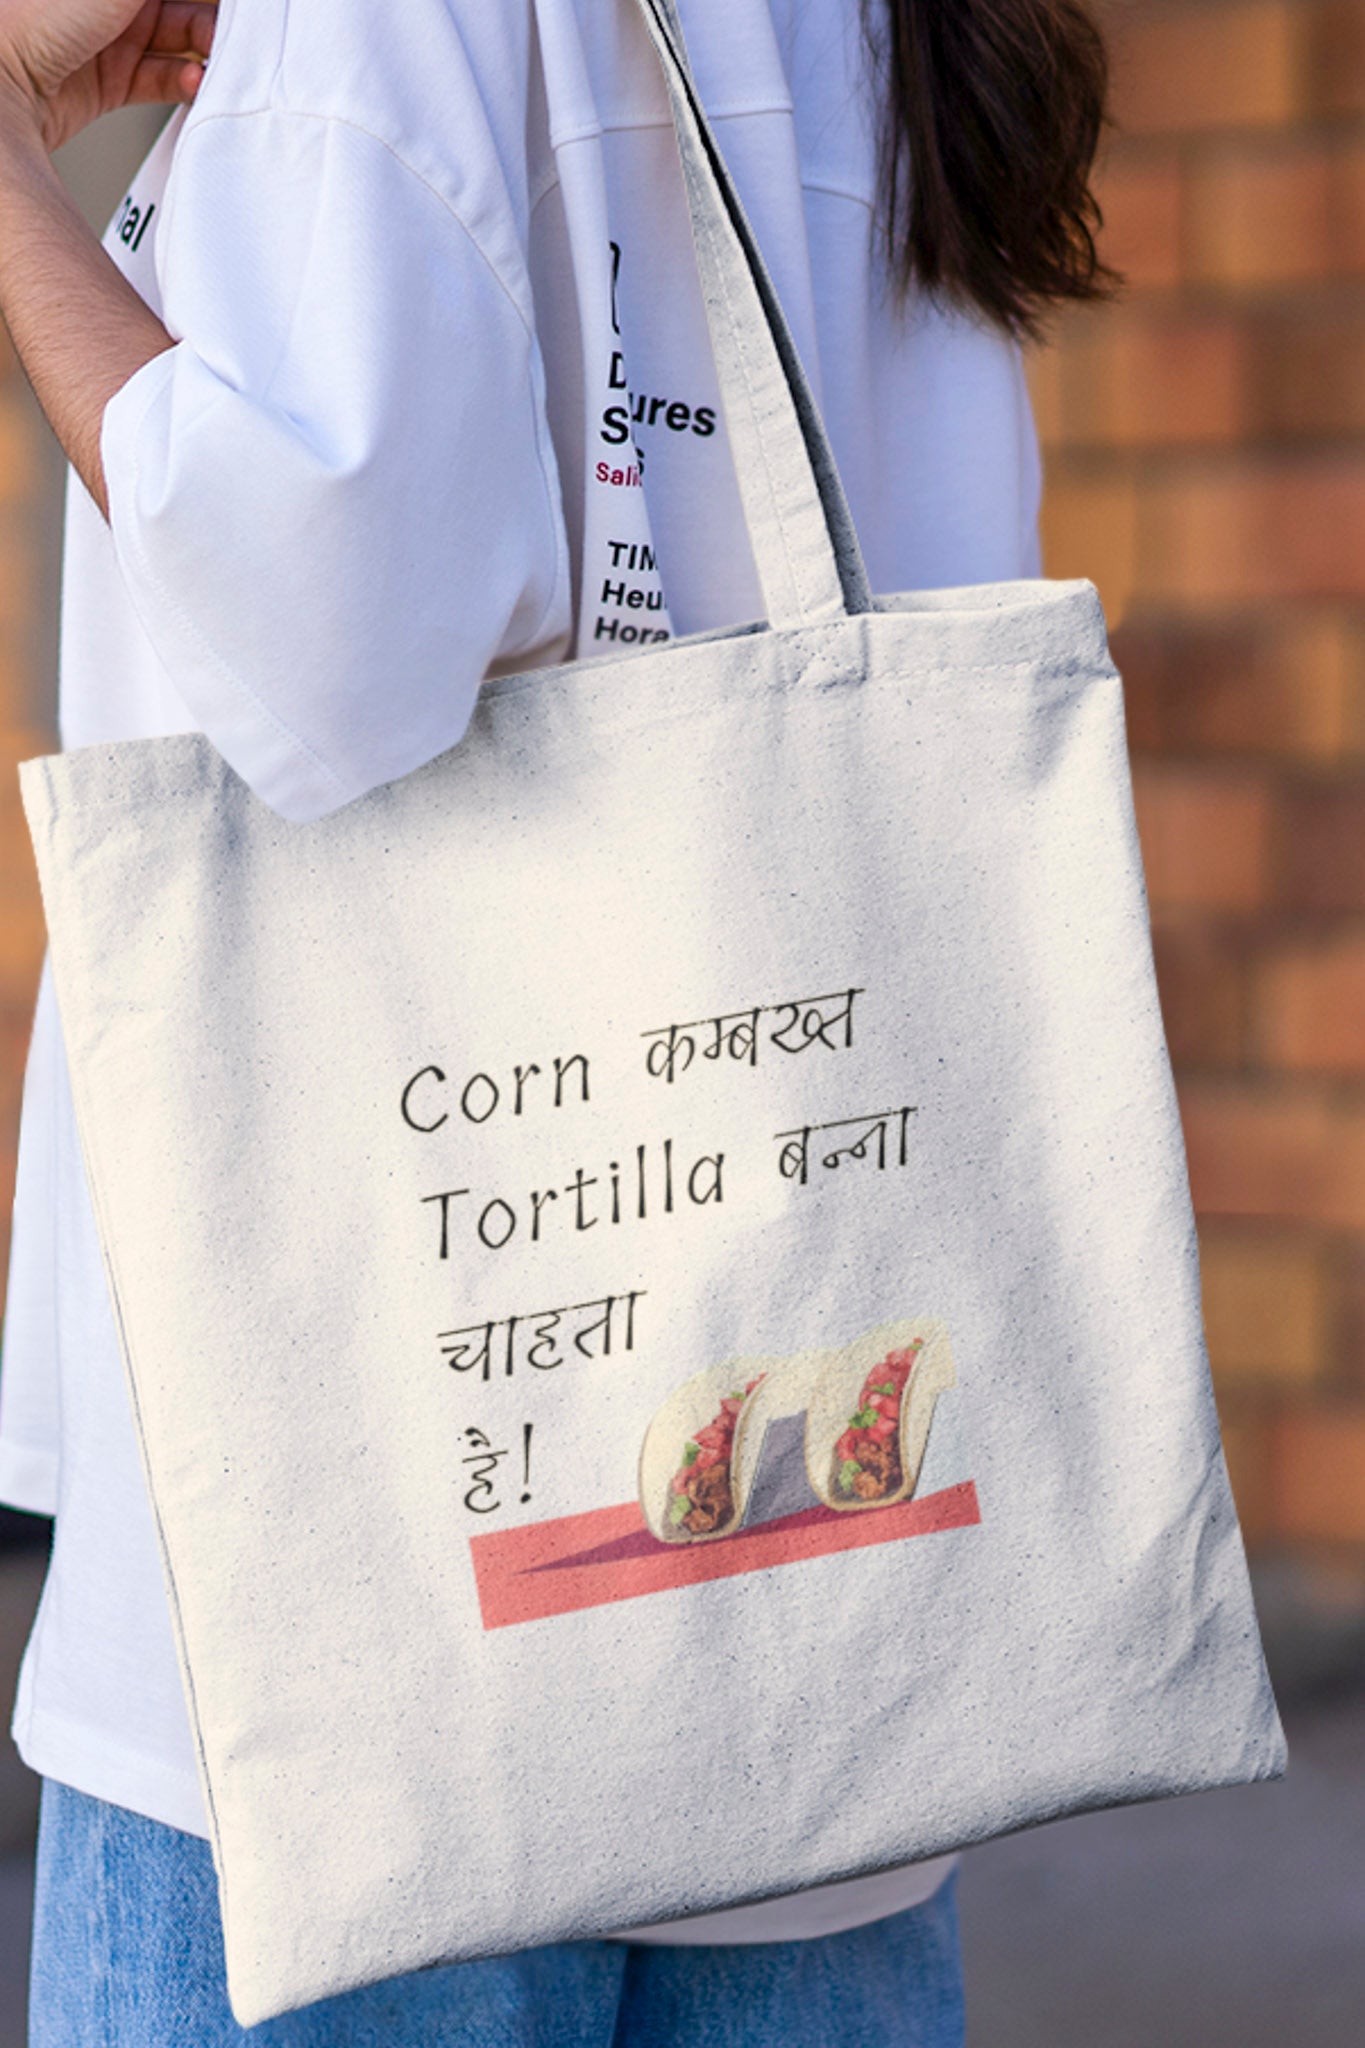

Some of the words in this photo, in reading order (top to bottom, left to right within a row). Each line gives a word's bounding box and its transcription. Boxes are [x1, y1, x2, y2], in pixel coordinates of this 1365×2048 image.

[595, 461, 643, 487] Sali
[600, 579, 668, 610] Heu
[400, 1053, 590, 1133] Corn
[640, 988, 866, 1084] कम्बख्त
[421, 1138, 725, 1260] Tortilla
[436, 1291, 648, 1382] चाहता
